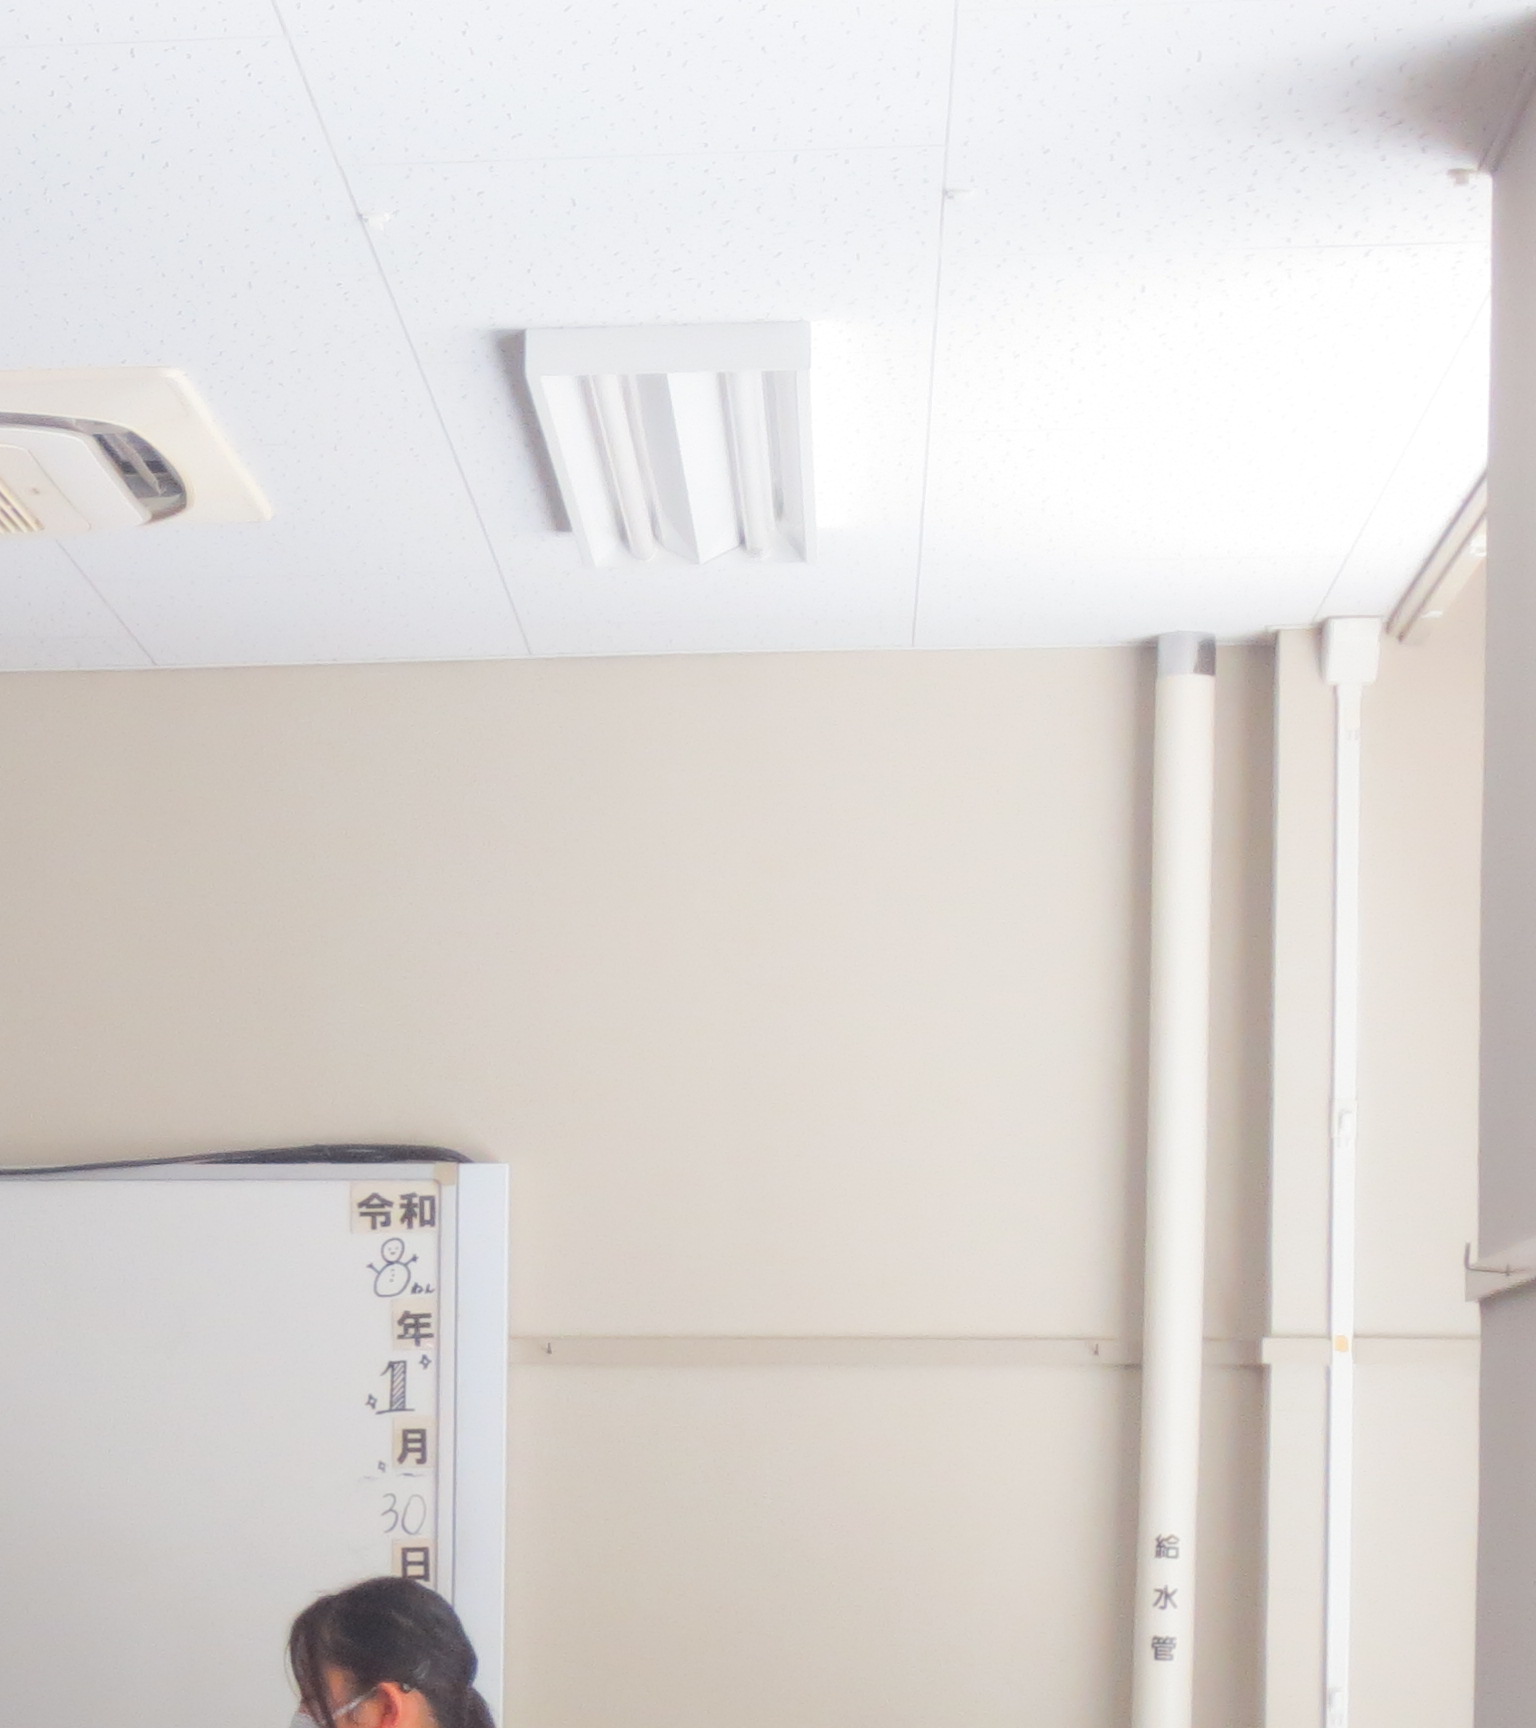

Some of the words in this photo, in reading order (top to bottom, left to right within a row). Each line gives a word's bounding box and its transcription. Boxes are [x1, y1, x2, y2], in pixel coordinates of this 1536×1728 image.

[357, 1192, 436, 1230] 令和
[397, 1311, 434, 1347] 年
[377, 1360, 415, 1414] 1
[397, 1428, 427, 1465] 月
[381, 1493, 427, 1535] 30
[401, 1547, 431, 1582] 日
[1151, 1533, 1180, 1661] 給水管
